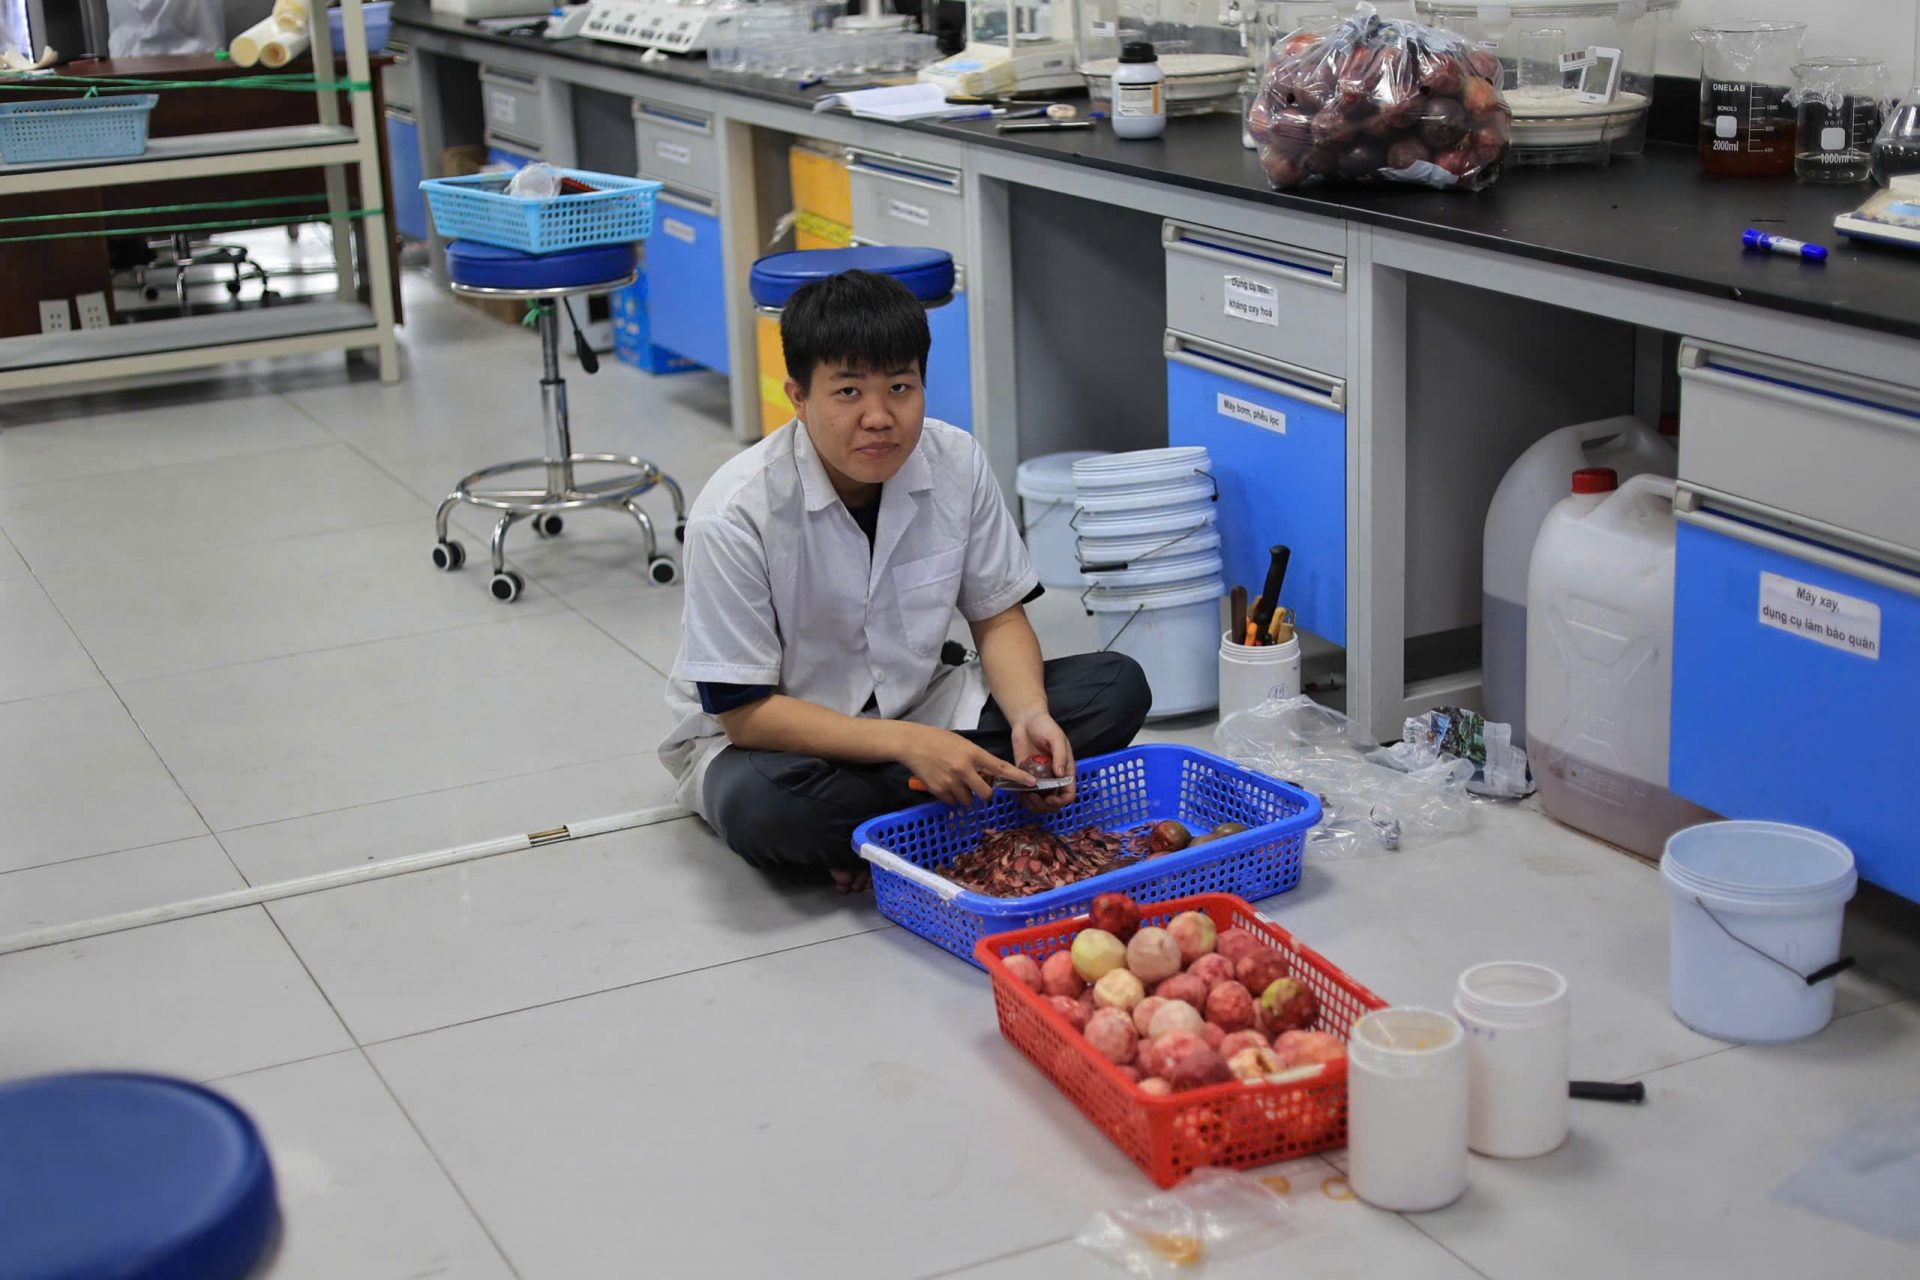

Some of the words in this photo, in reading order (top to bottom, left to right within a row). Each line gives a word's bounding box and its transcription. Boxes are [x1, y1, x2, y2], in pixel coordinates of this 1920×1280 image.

[1712, 83, 1746, 92] ONELAB
[1712, 140, 1739, 152] 2000ml
[1248, 305, 1260, 316] oxy
[1796, 587, 1818, 606] Máy
[1763, 605, 1788, 625] dụng
[1790, 615, 1803, 628] cụ
[1805, 618, 1824, 634] làm
[1826, 625, 1846, 641] bảo
